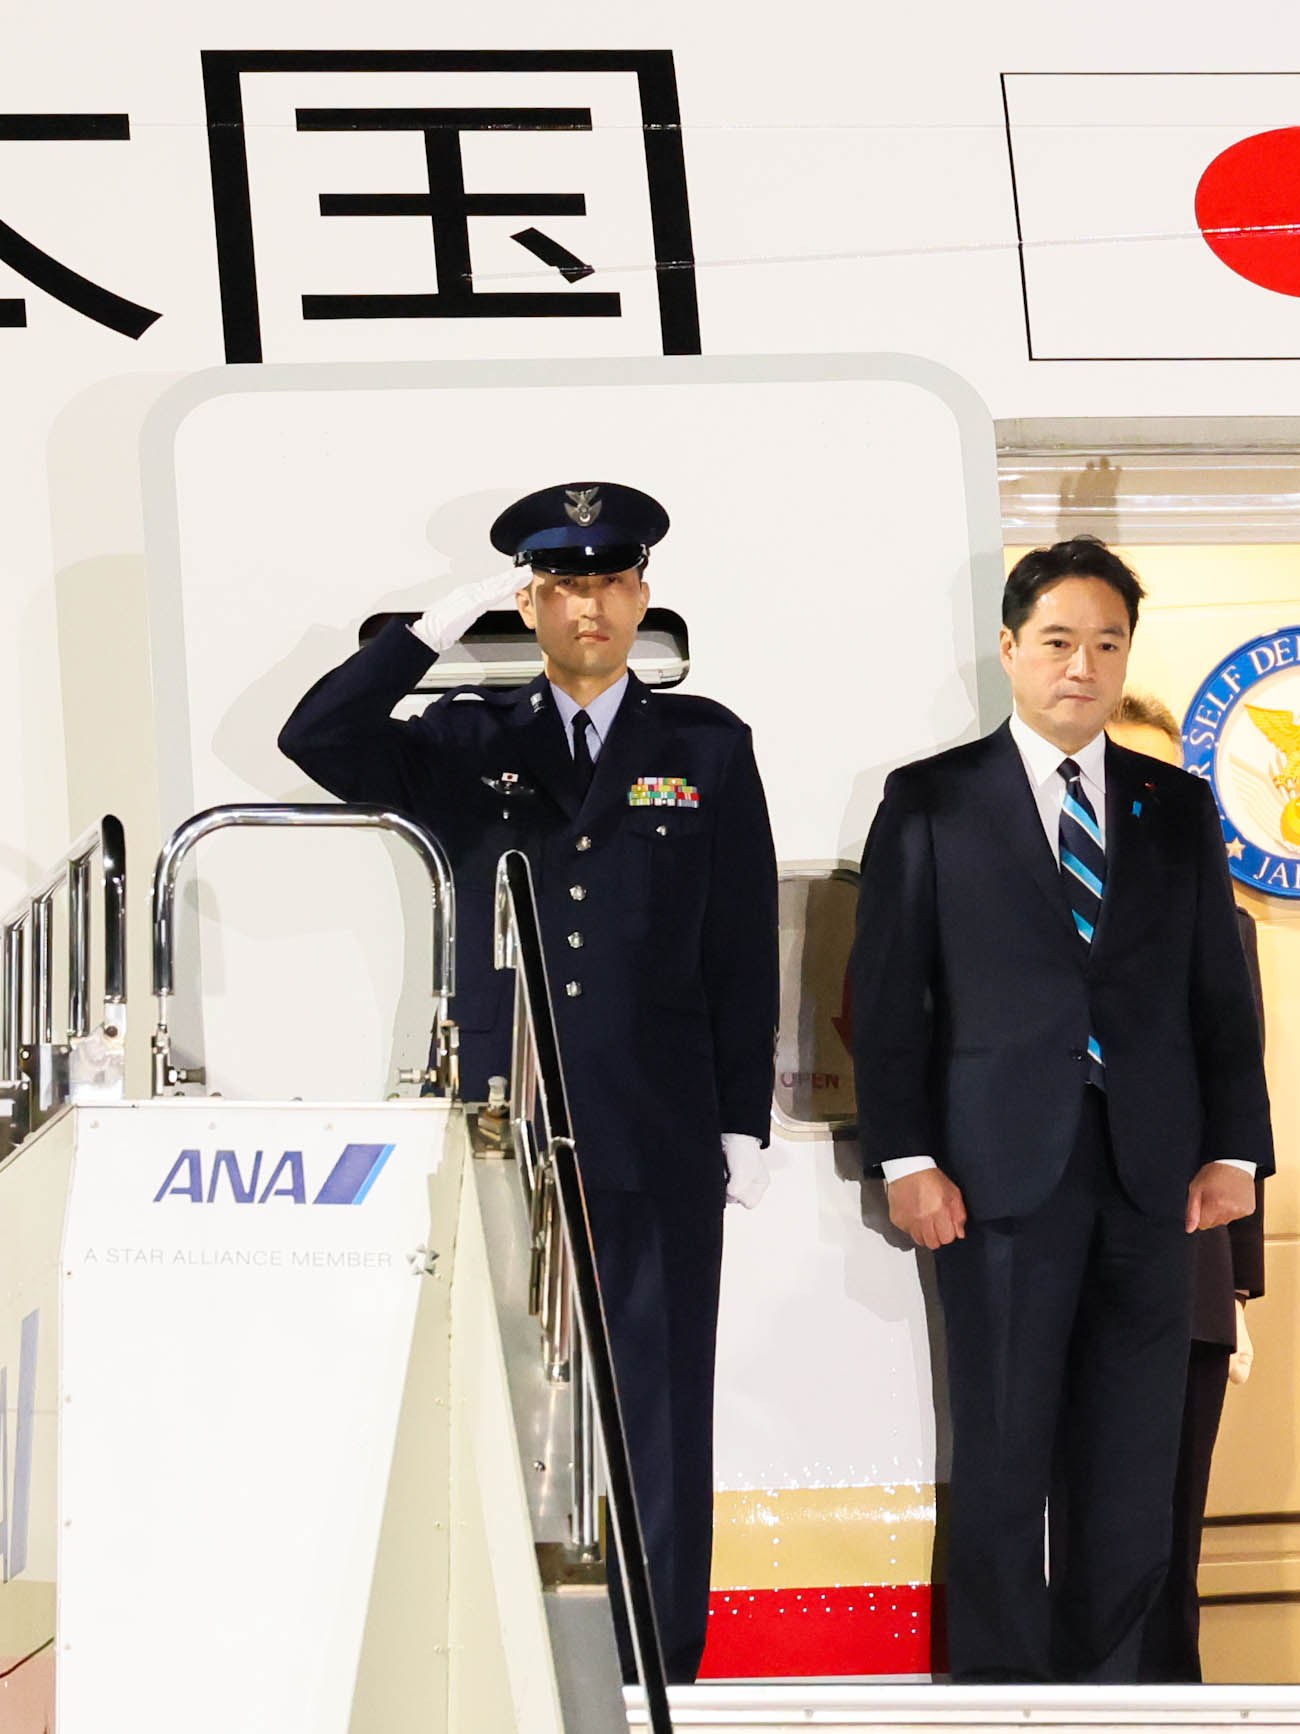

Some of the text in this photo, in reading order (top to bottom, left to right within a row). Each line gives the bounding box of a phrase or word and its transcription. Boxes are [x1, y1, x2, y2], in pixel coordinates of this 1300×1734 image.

[1189, 665, 1241, 749] SELF
[152, 1149, 306, 1204] ANA
[84, 1248, 392, 1268] A STAR ALLIANCE MEMBER
